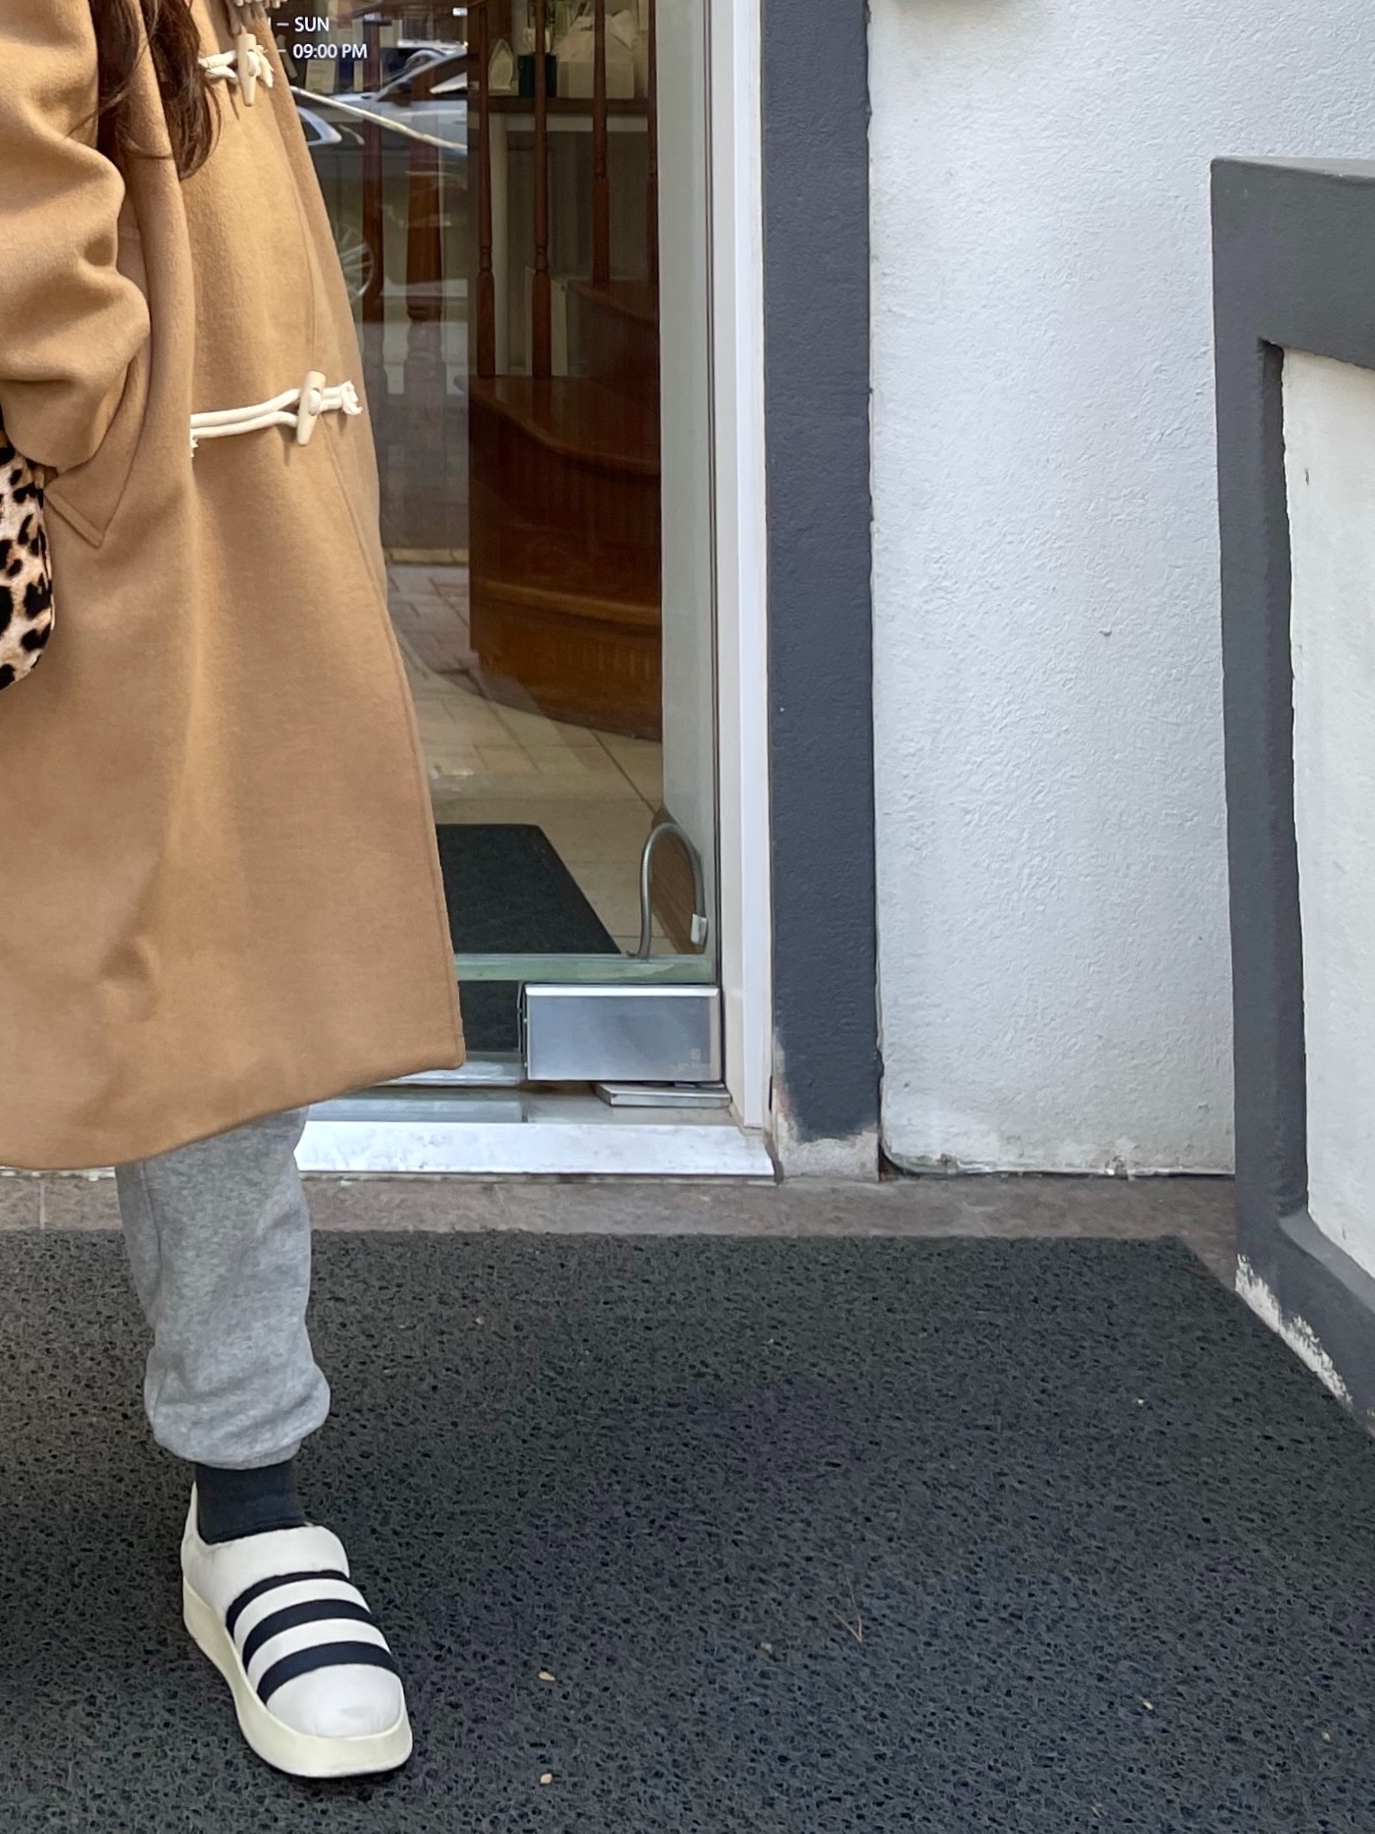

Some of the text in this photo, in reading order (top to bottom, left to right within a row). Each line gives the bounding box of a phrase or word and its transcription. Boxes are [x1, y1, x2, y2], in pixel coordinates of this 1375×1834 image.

[294, 16, 330, 32] SUN
[293, 43, 338, 59] 09:00
[341, 43, 368, 59] PM
